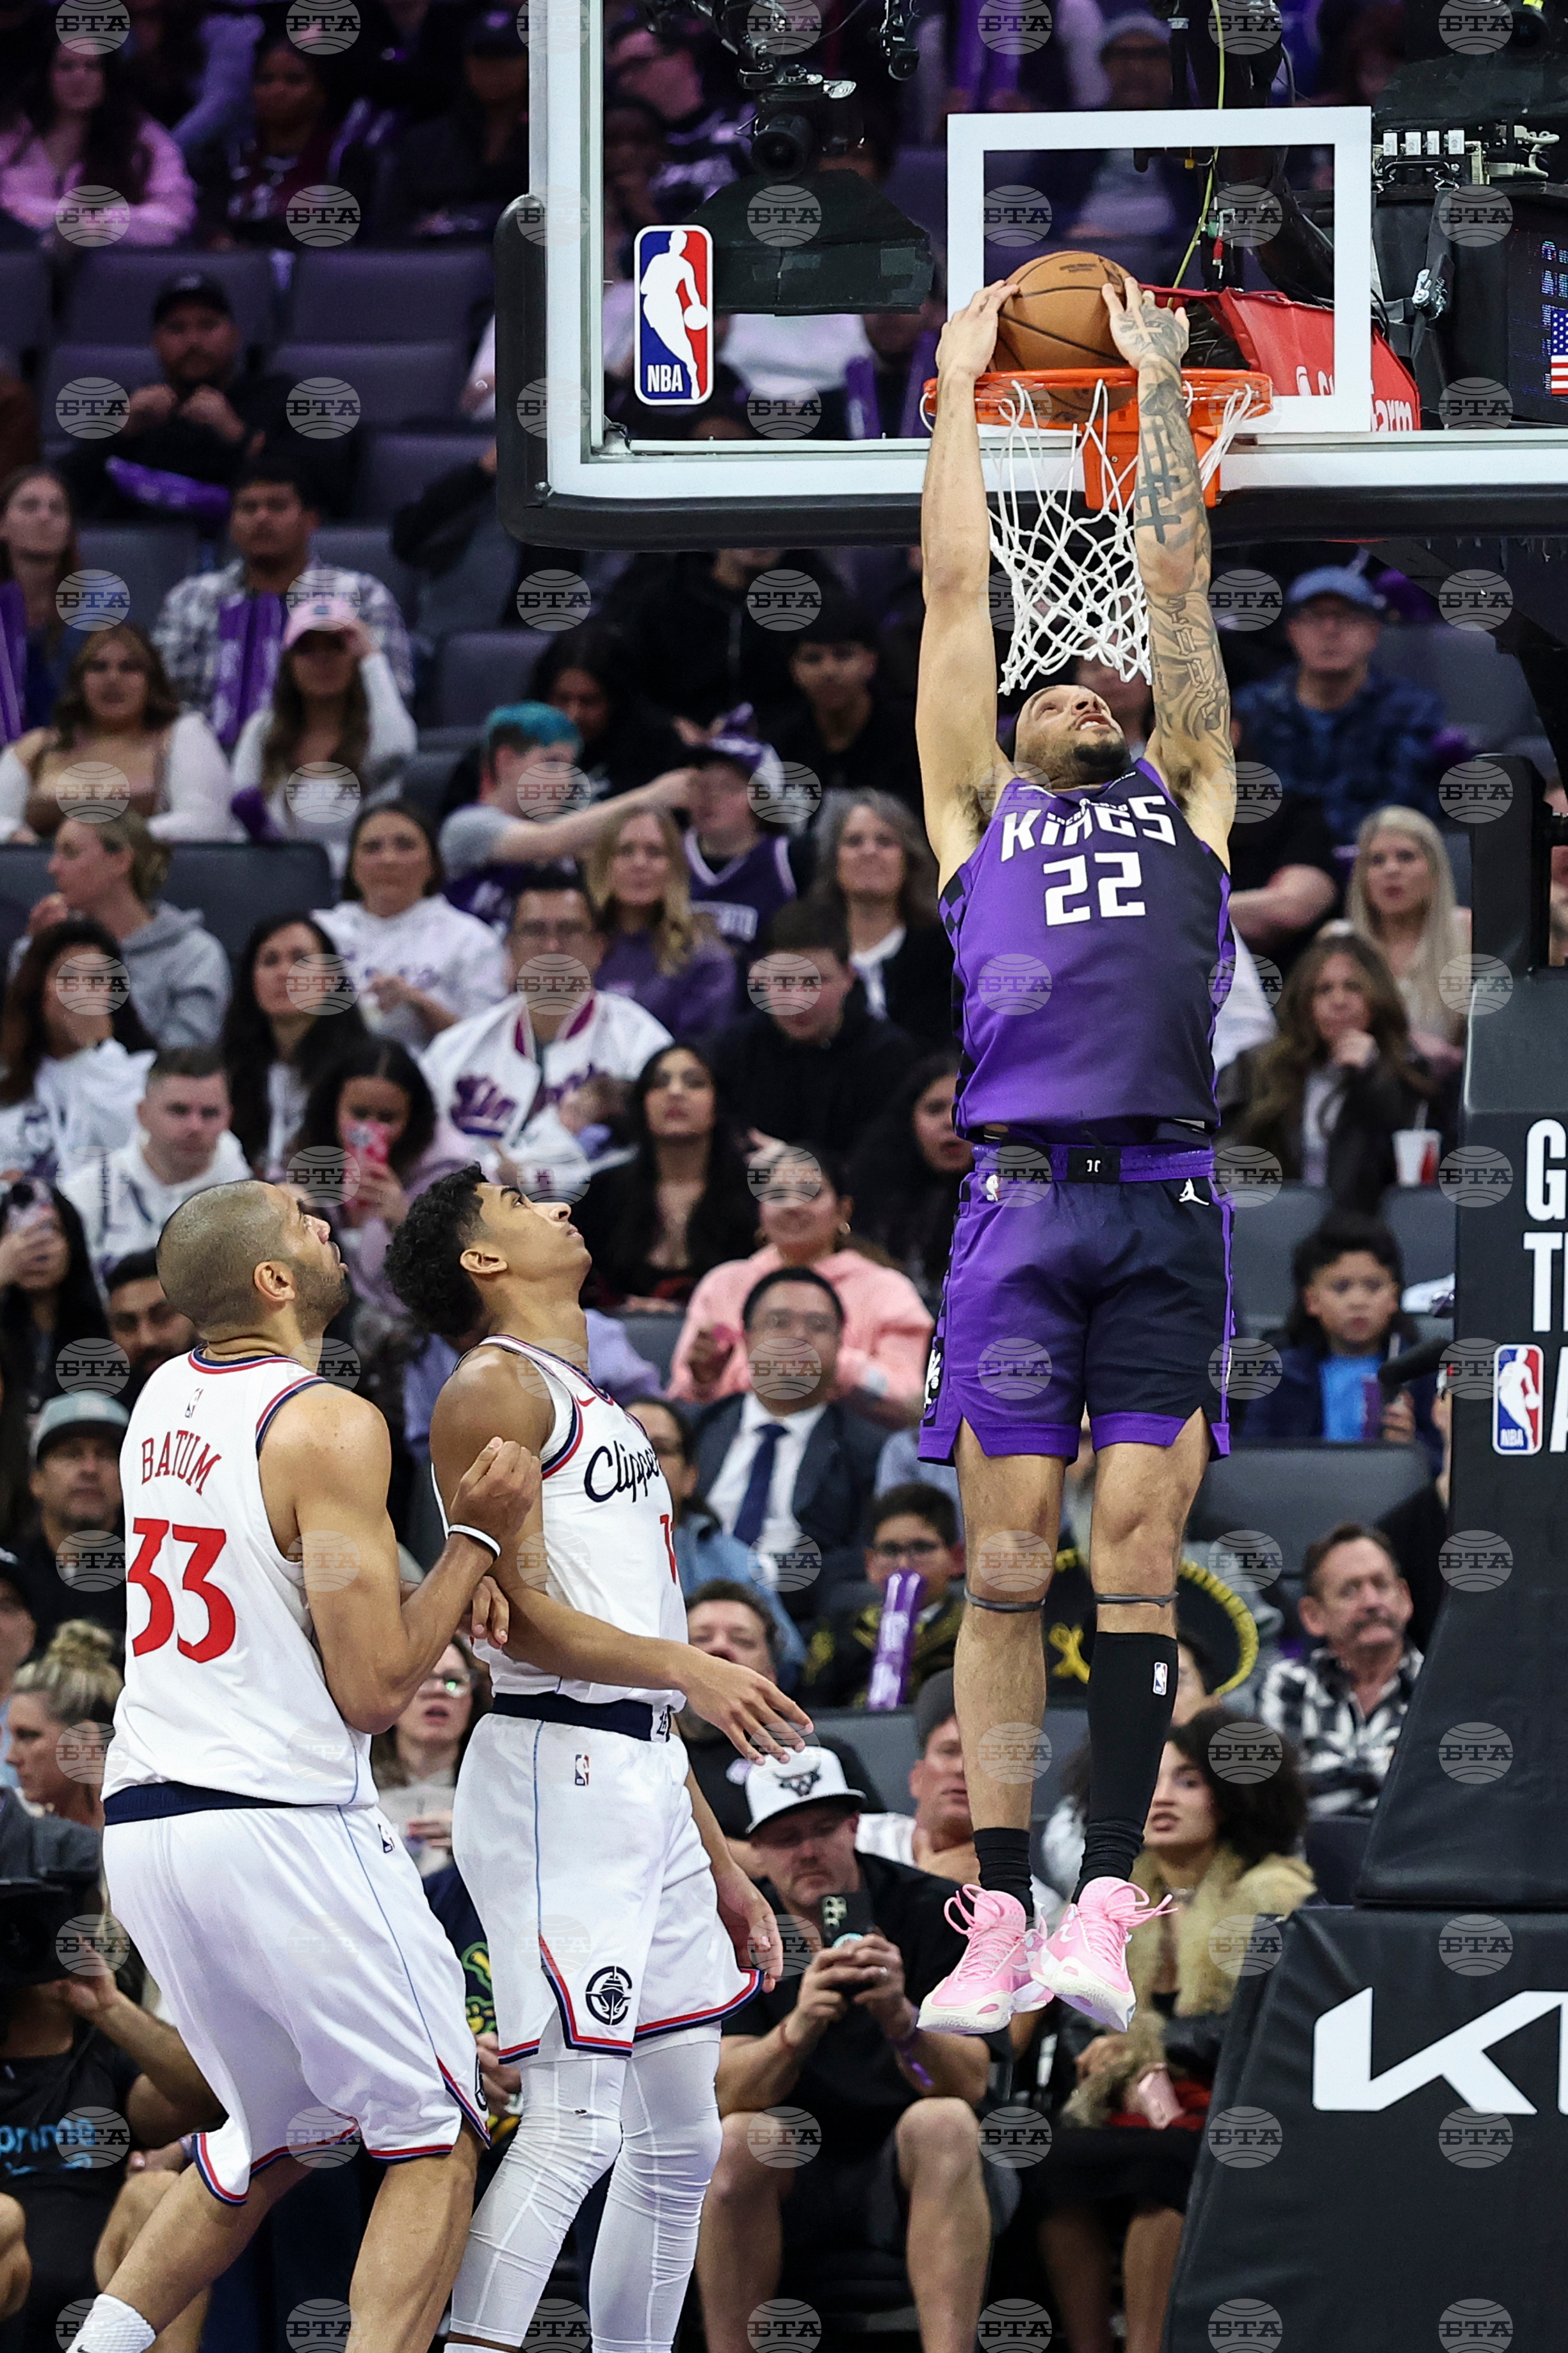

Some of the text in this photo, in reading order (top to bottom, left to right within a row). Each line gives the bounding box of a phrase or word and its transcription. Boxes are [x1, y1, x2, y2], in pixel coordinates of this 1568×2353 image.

[647, 364, 683, 392] NBA
[1001, 795, 1176, 863] KINGS
[1043, 852, 1145, 925] 22
[1523, 1232, 1568, 1331] T
[141, 1429, 222, 1496] BATUM
[1499, 1428, 1524, 1447] NBA
[127, 1517, 236, 1663] 33
[1312, 1986, 1568, 2115] K
